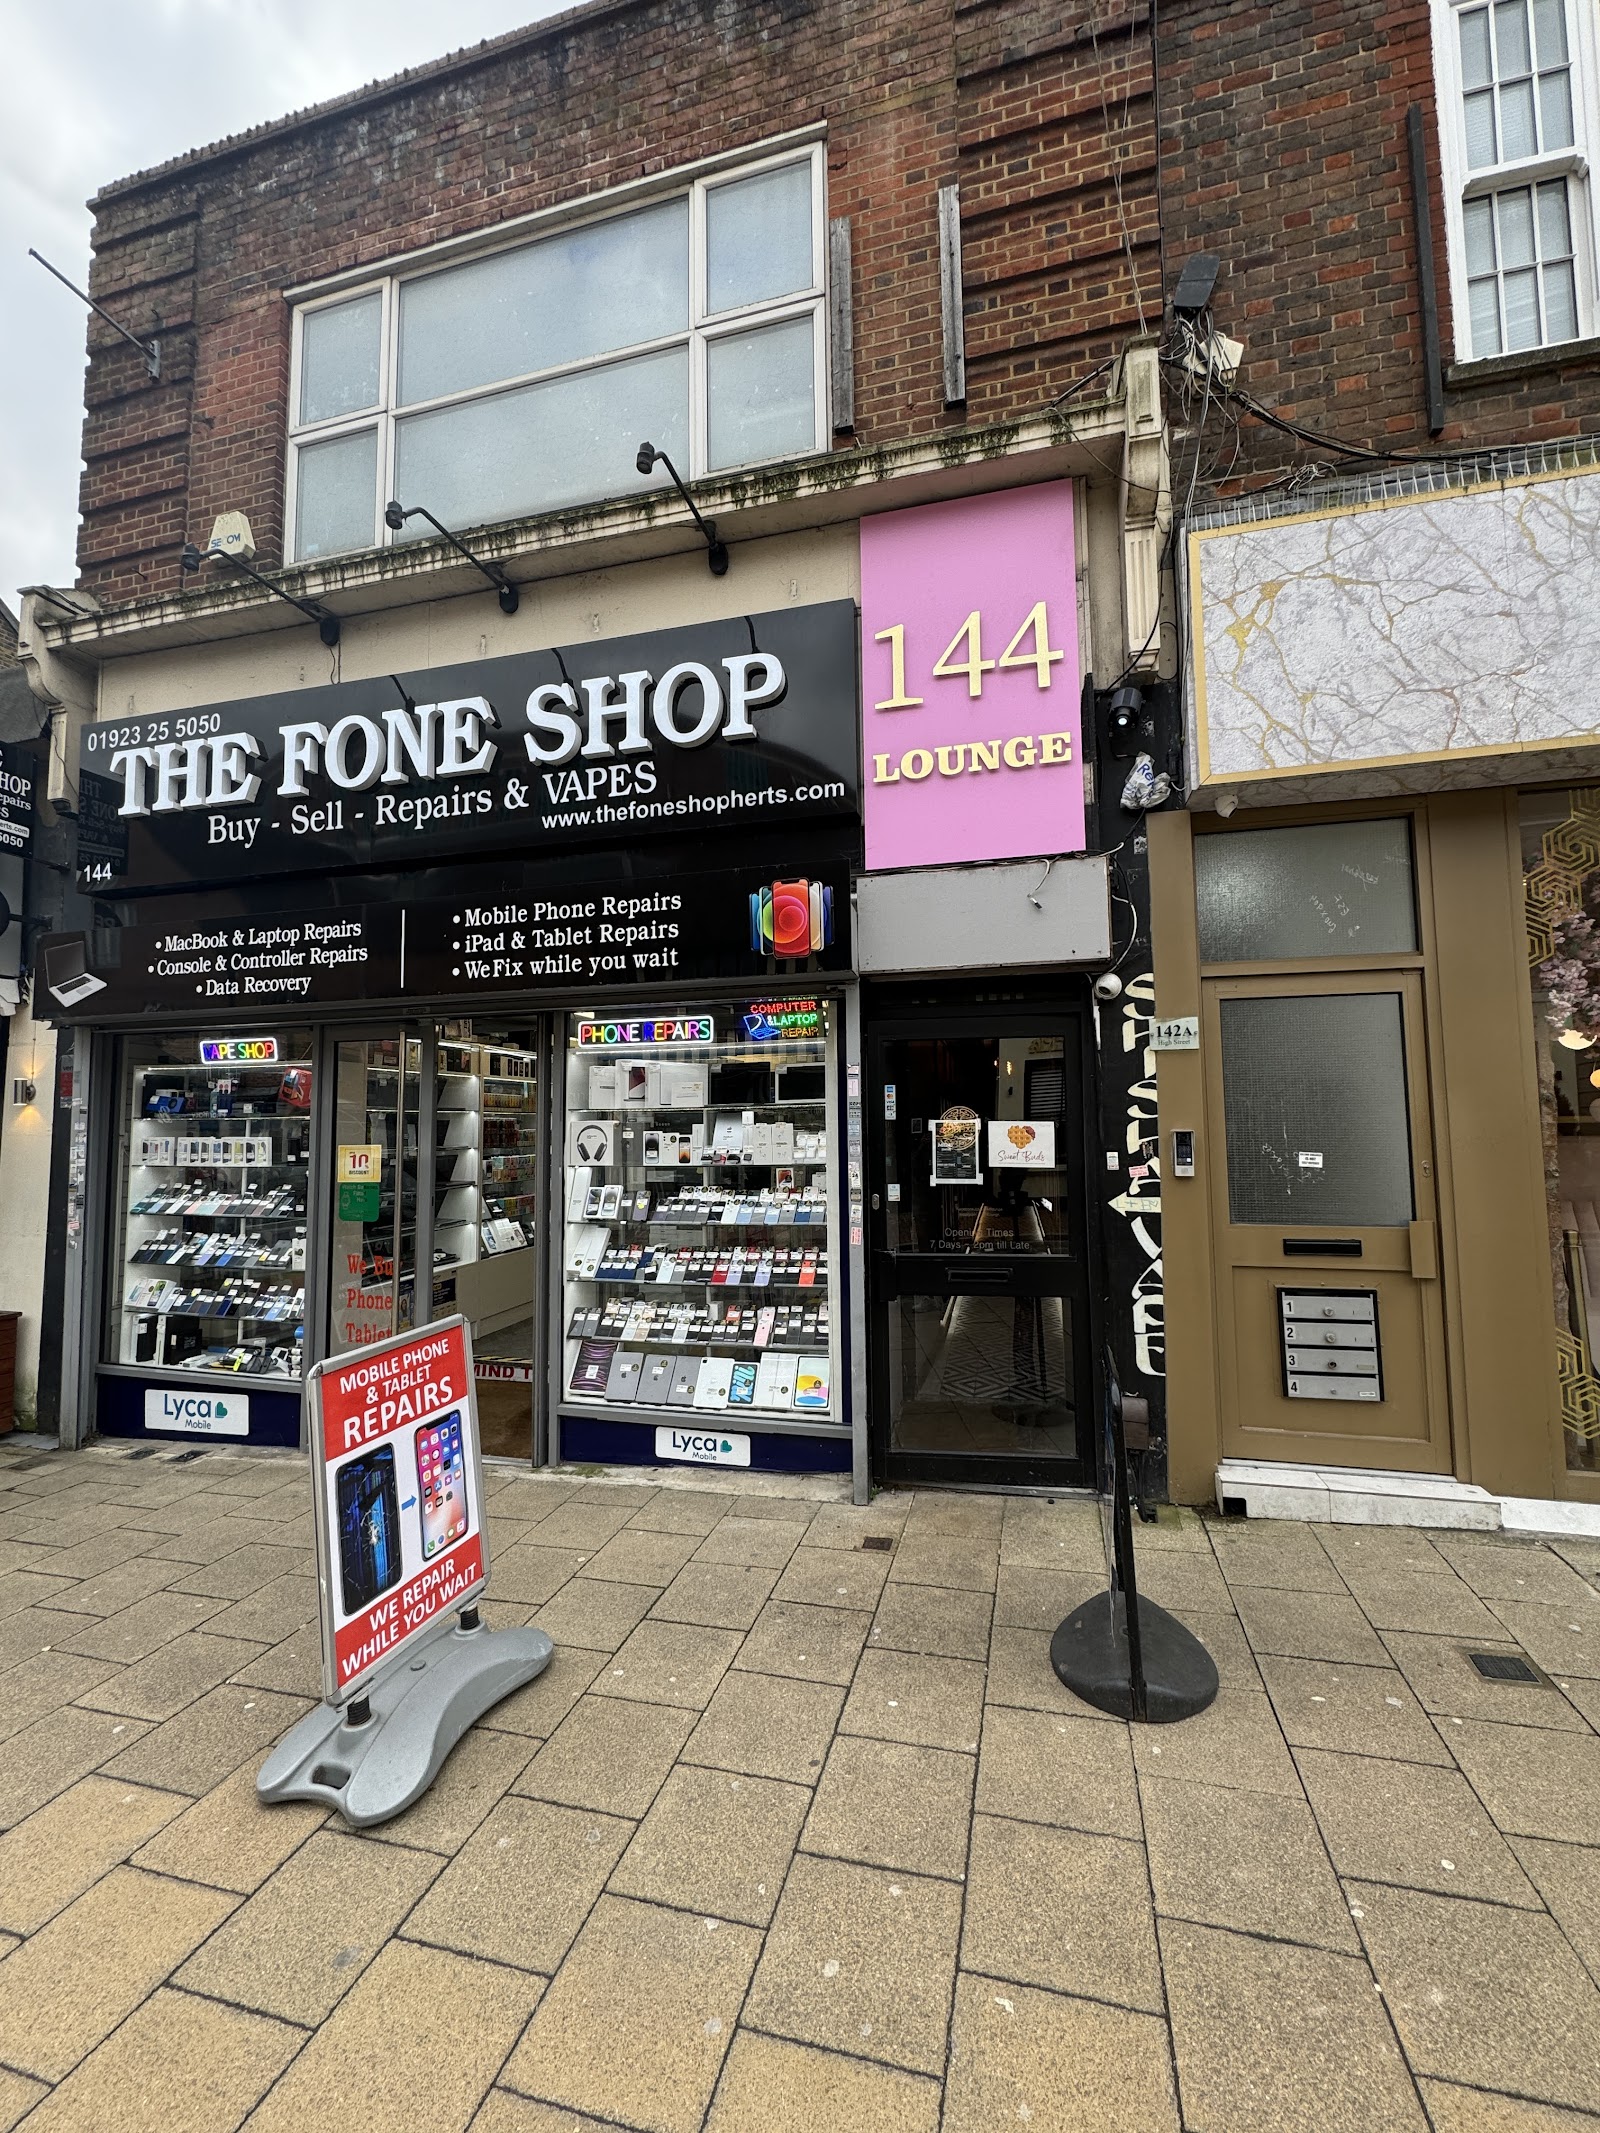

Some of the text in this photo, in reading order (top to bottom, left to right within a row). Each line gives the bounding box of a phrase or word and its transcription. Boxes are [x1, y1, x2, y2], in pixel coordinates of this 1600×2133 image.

[211, 533, 240, 549] SEOM
[874, 601, 1064, 711] 144
[88, 713, 221, 751] 01923 25 5050
[109, 652, 786, 817] THE FONE SHOP
[872, 732, 1072, 783] LOUNGE
[0, 771, 31, 797] HOP
[0, 793, 31, 811] epairs
[207, 814, 261, 849] Buy
[290, 800, 344, 835] Sell
[376, 787, 493, 830] Repairs
[507, 778, 530, 810] &
[542, 760, 658, 805] VAPES
[542, 780, 845, 830] www.thefoneshopherts.com
[84, 862, 112, 882] 144
[464, 892, 682, 927] Mobile Phone Repairs
[164, 919, 362, 952] MacBook & Laptop Repairs
[464, 919, 680, 953] iPad & Tablet Repairs
[156, 944, 368, 977] Console & Controller Repairs
[530, 954, 583, 975] while
[588, 954, 627, 977] you
[632, 947, 679, 969] wait
[205, 976, 312, 997] Data Recovery
[750, 1000, 817, 1014] COMPUTER
[581, 1020, 711, 1043] PHONE REPAIRS
[1156, 1024, 1192, 1037] 142A
[203, 1041, 274, 1060] VAPE SHOP
[1158, 1039, 1172, 1047] High
[997, 1149, 1020, 1162] Sweet
[986, 1228, 1014, 1237] Times
[929, 1240, 936, 1249] 7
[938, 1240, 961, 1251] Days
[996, 1241, 1007, 1249] till
[1010, 1241, 1030, 1249] Late
[347, 1254, 400, 1276] We Bu
[346, 1288, 393, 1310] Phone
[1286, 1302, 1292, 1312] 1
[1286, 1327, 1294, 1338] 2
[340, 1338, 451, 1395] MOBILE PHONE
[1288, 1355, 1296, 1366] 3
[366, 1363, 432, 1405] & TABLET
[1290, 1381, 1298, 1392] 4
[164, 1393, 212, 1421] Lyca
[343, 1376, 453, 1449] REPAIRS
[184, 1418, 212, 1430] Mobile
[672, 1431, 718, 1455] Lyca
[692, 1451, 718, 1461] Mobile
[368, 1558, 455, 1632] WE REPAIR
[341, 1562, 477, 1678] WHILE YOU WAIT
